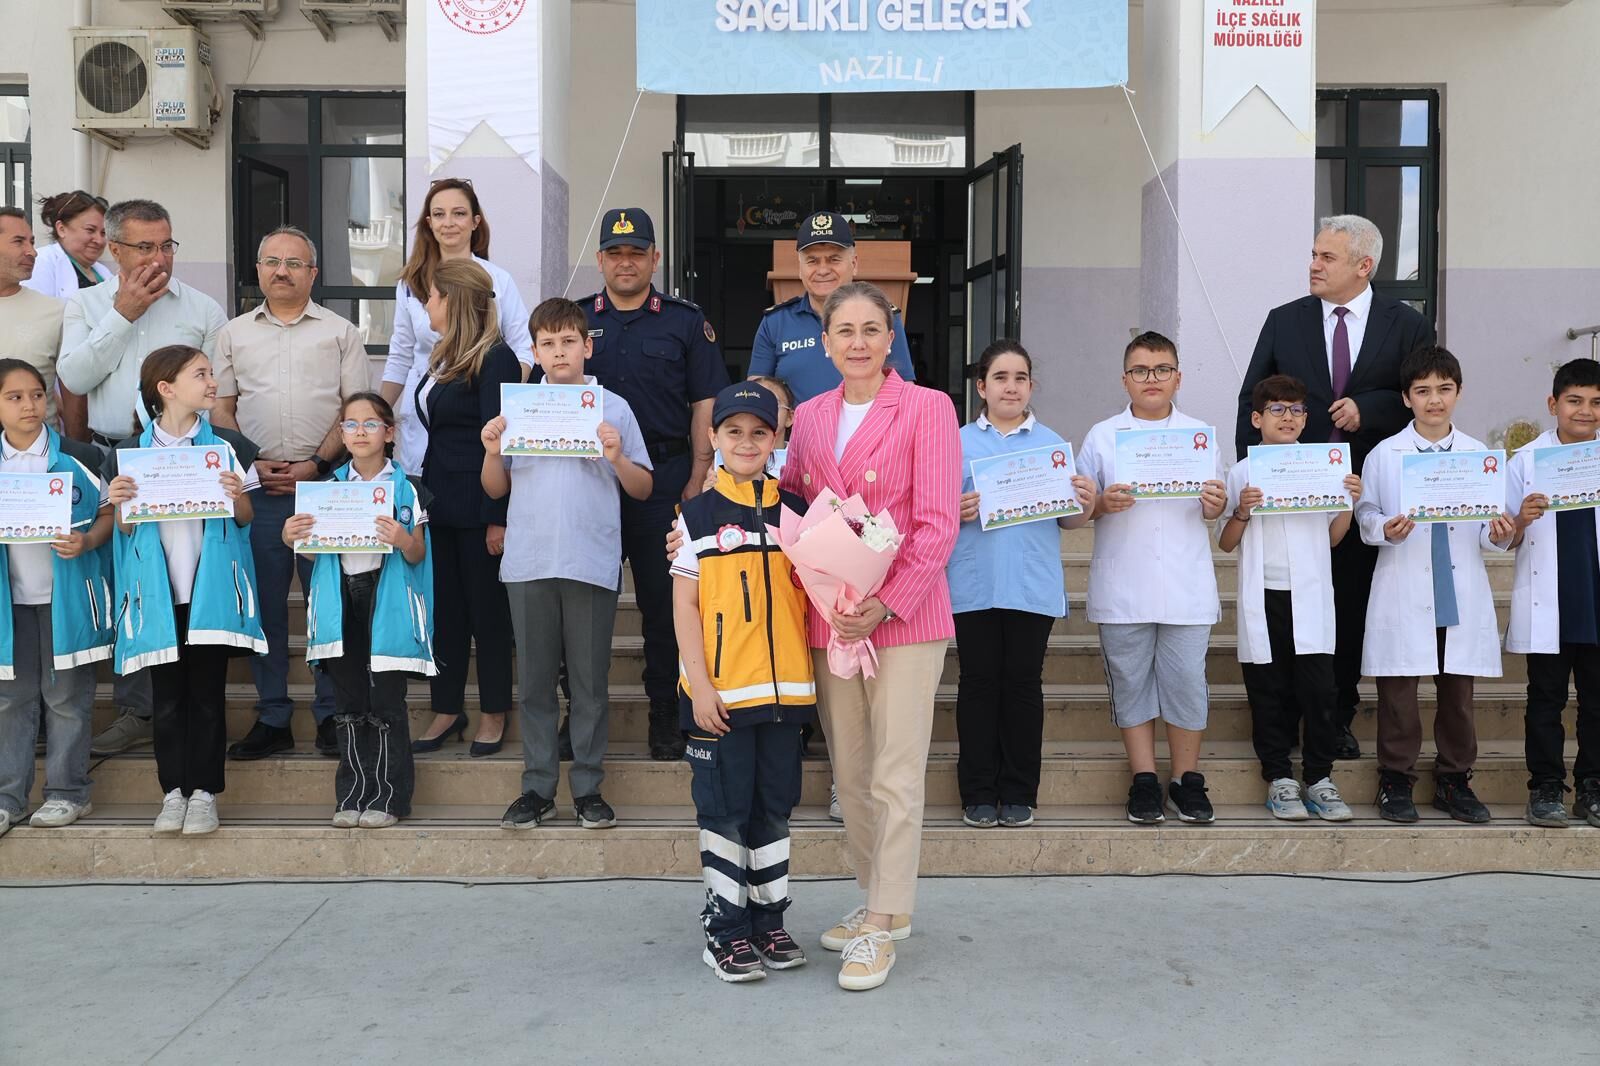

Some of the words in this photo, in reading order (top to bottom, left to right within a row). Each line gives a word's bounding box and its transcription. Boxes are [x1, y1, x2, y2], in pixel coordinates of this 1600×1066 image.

[877, 0, 1033, 31] GELECEK
[1216, 9, 1247, 31] İLÇE
[1251, 10, 1301, 26] SAĞLIK
[1213, 30, 1303, 47] MÜDÜRLÜĞÜ
[818, 50, 945, 86] NAZİLLİ
[781, 337, 816, 352] POLIS
